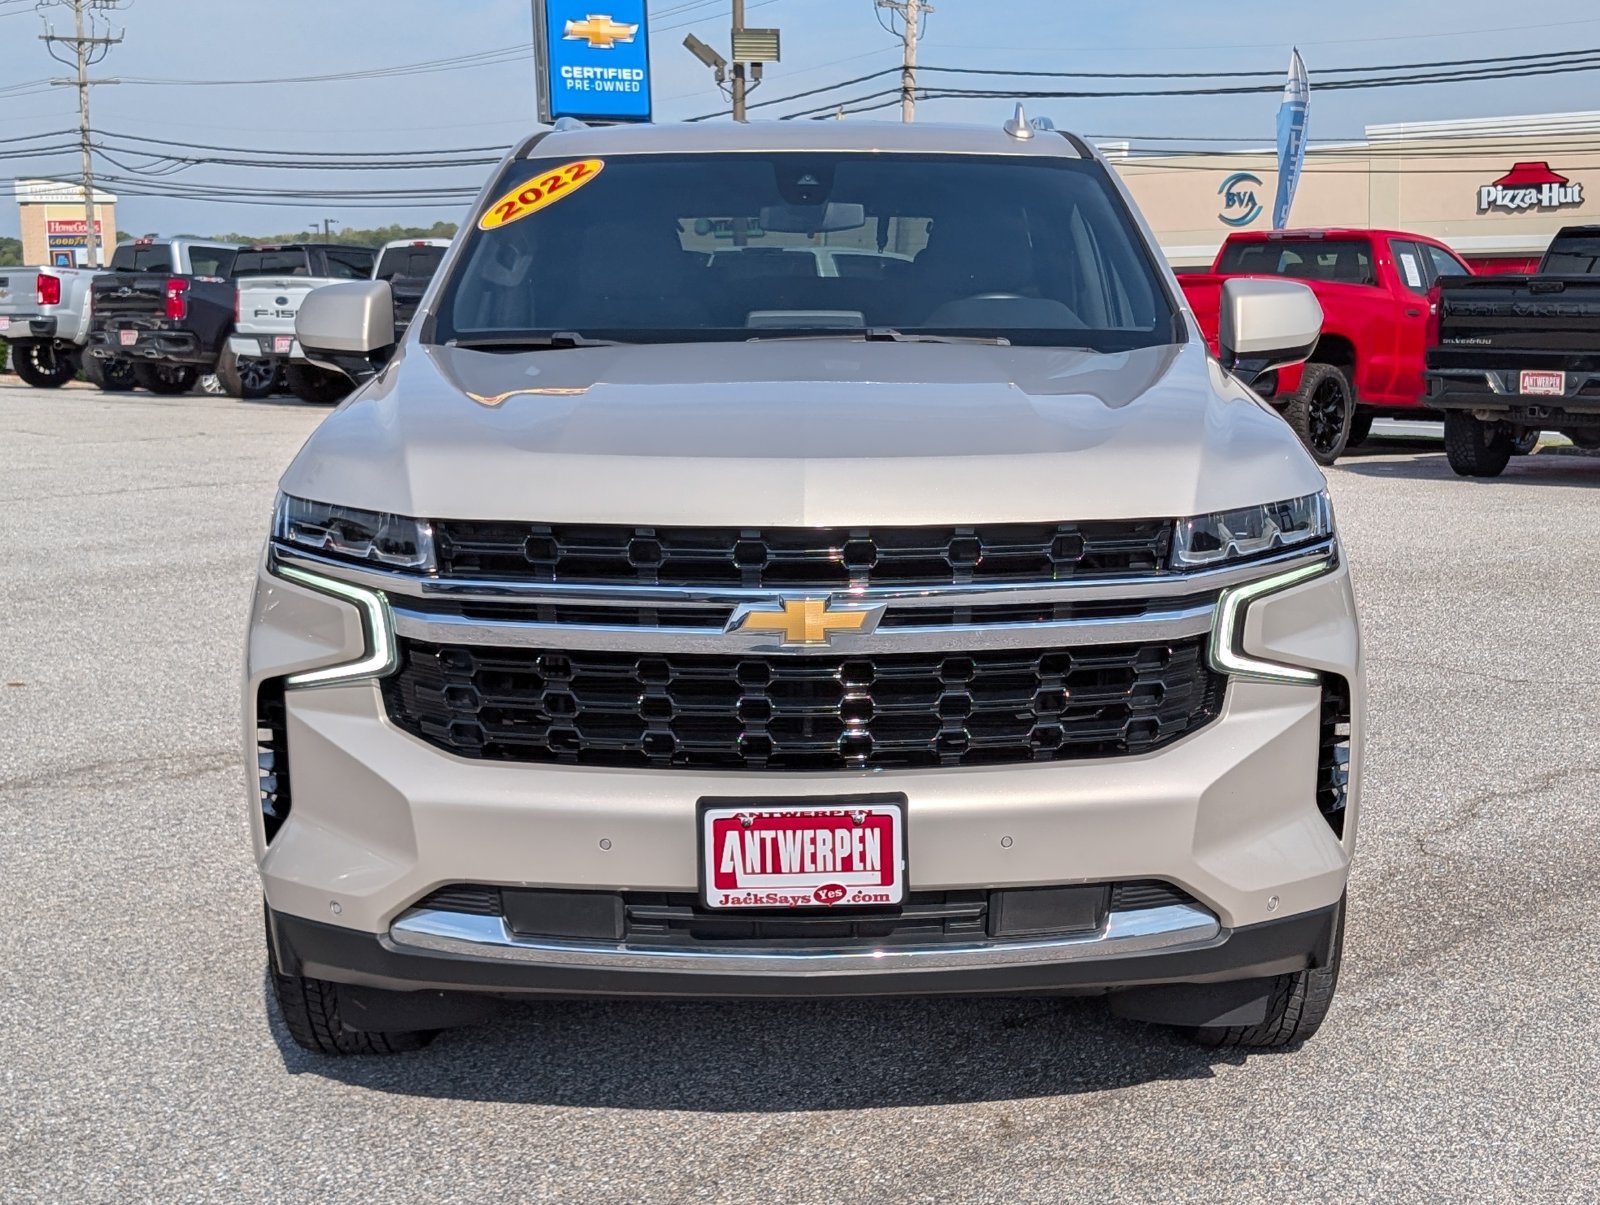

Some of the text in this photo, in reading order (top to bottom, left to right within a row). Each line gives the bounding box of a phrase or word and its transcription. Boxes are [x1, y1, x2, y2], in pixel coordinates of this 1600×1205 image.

[561, 66, 644, 80] CERTIFIED
[567, 79, 640, 92] PRE-OWNED
[494, 163, 593, 222] 2022
[1480, 183, 1583, 209] Pizza Hut
[1225, 191, 1258, 209] BVA
[50, 222, 100, 233] HomeGos
[50, 237, 100, 246] GOODYR
[254, 309, 299, 318] F-15
[1523, 376, 1561, 388] ANTWERPEN
[720, 827, 881, 875] ANTWERPEN
[719, 893, 811, 908] JackSays
[818, 888, 843, 900] Yes
